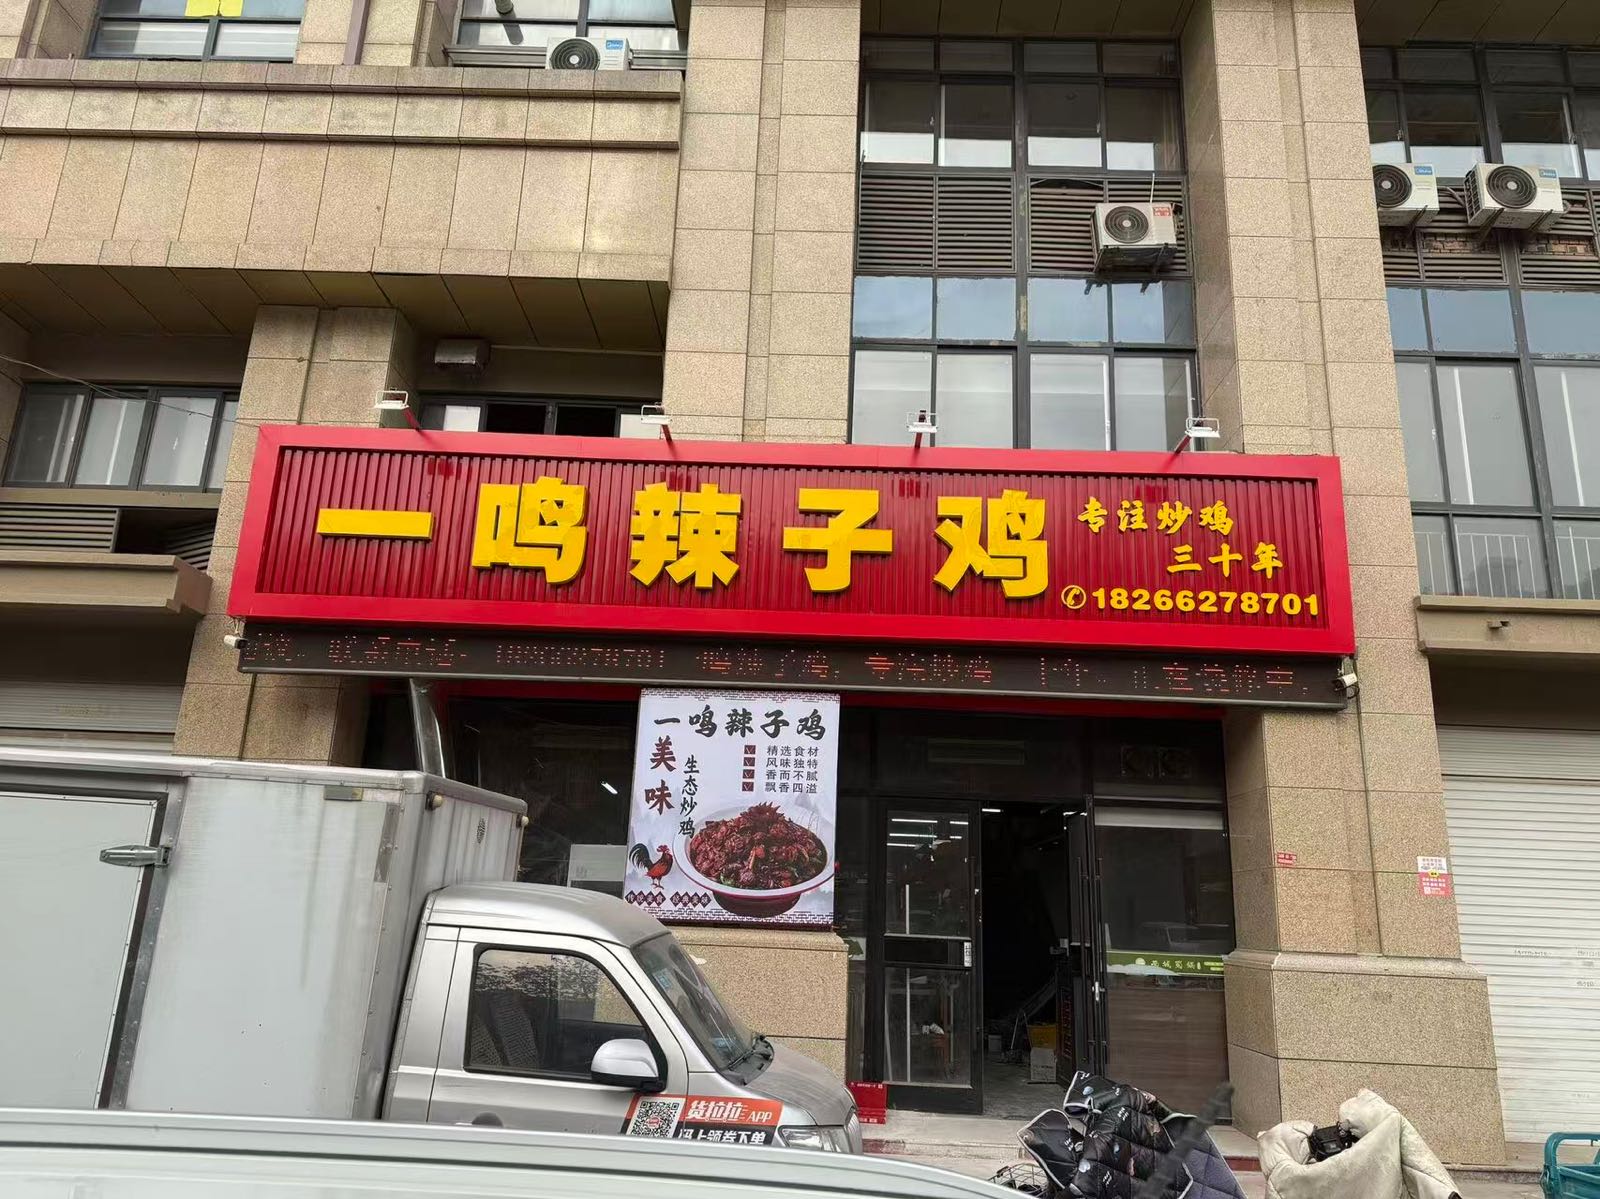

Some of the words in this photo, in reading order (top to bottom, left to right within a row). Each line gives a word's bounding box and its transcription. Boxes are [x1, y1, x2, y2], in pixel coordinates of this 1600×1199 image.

[1077, 496, 1234, 536] 专注炒鸡
[316, 476, 1048, 599] 一鸣辣子鸡
[1166, 541, 1283, 579] 三十年
[1092, 587, 1319, 616] 18266278701
[653, 704, 826, 741] 一鸣辣子鸡
[765, 758, 819, 770] 风味独特
[766, 745, 819, 757] 精选食材
[644, 735, 677, 815] 美味
[764, 782, 818, 794] 飘香四溢
[765, 769, 819, 781] 香而不腻
[678, 755, 700, 839] 生态炒鸡
[685, 1100, 746, 1122] 货拉拉
[746, 1111, 773, 1123] APP
